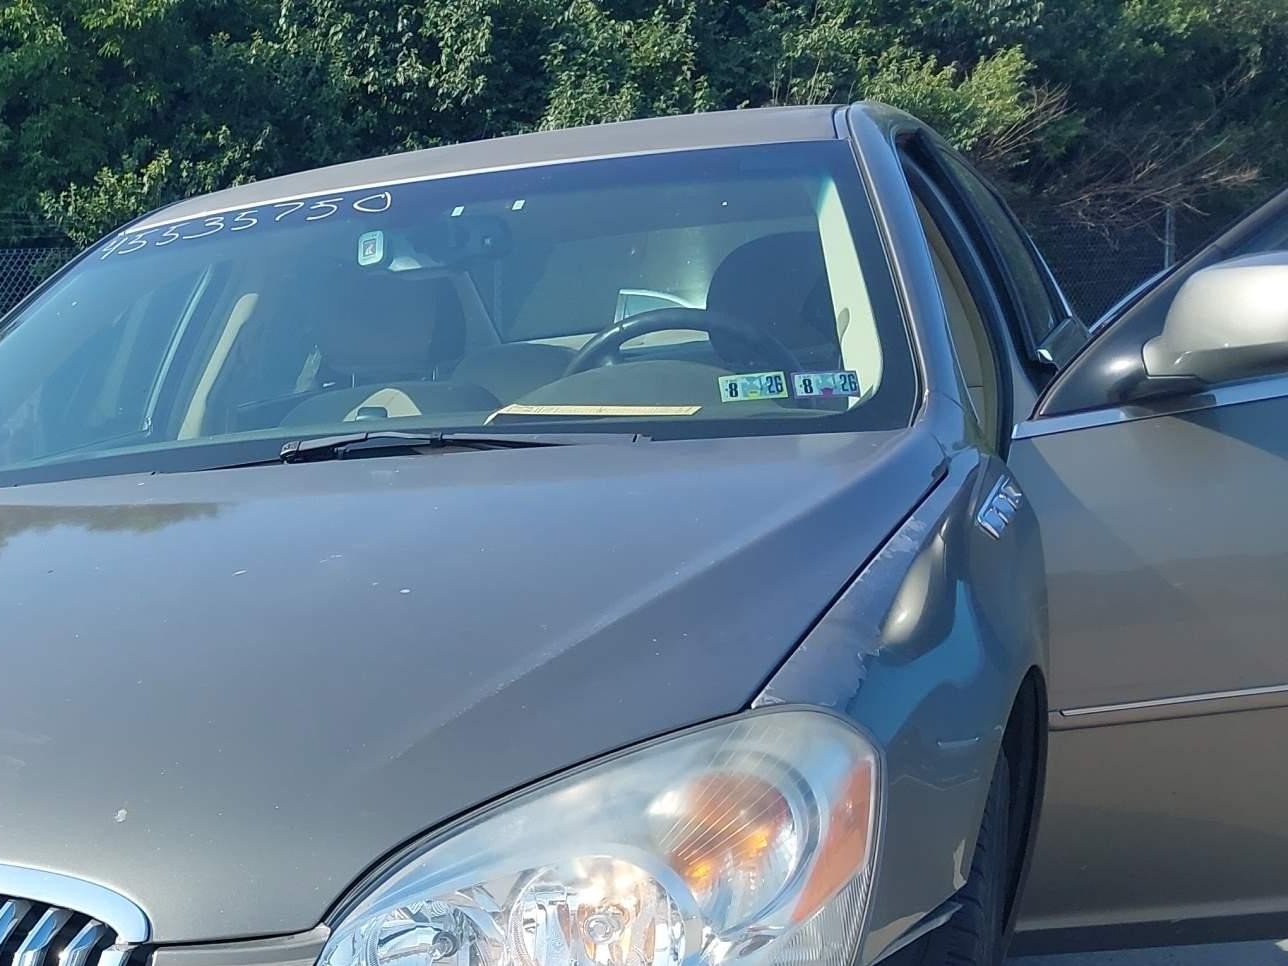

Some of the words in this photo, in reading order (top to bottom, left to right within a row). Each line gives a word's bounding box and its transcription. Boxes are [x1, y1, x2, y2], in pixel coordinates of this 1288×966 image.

[100, 191, 393, 260] 45535750
[728, 382, 739, 398] 8
[765, 375, 784, 394] 26
[802, 378, 814, 394] 8
[839, 373, 858, 393] 26
